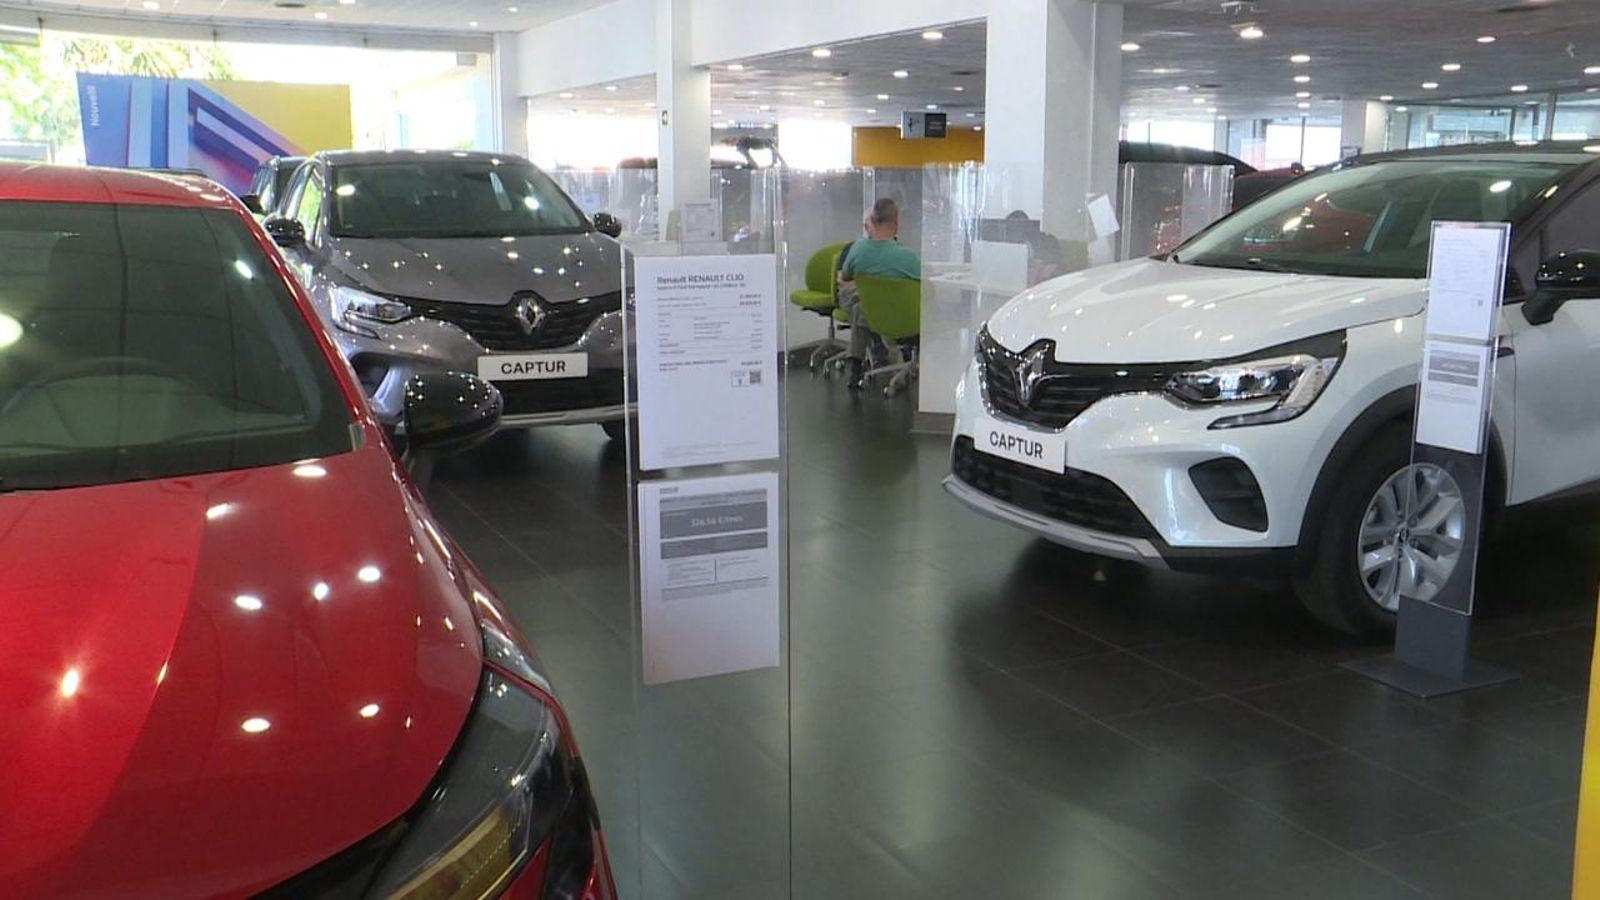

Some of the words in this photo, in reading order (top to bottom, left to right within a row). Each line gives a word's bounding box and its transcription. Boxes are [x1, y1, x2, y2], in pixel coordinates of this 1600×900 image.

[688, 273, 724, 283] RENAULT
[725, 273, 744, 281] CLIO
[501, 360, 566, 375] CAPTUR
[989, 431, 1043, 459] CAPTUR
